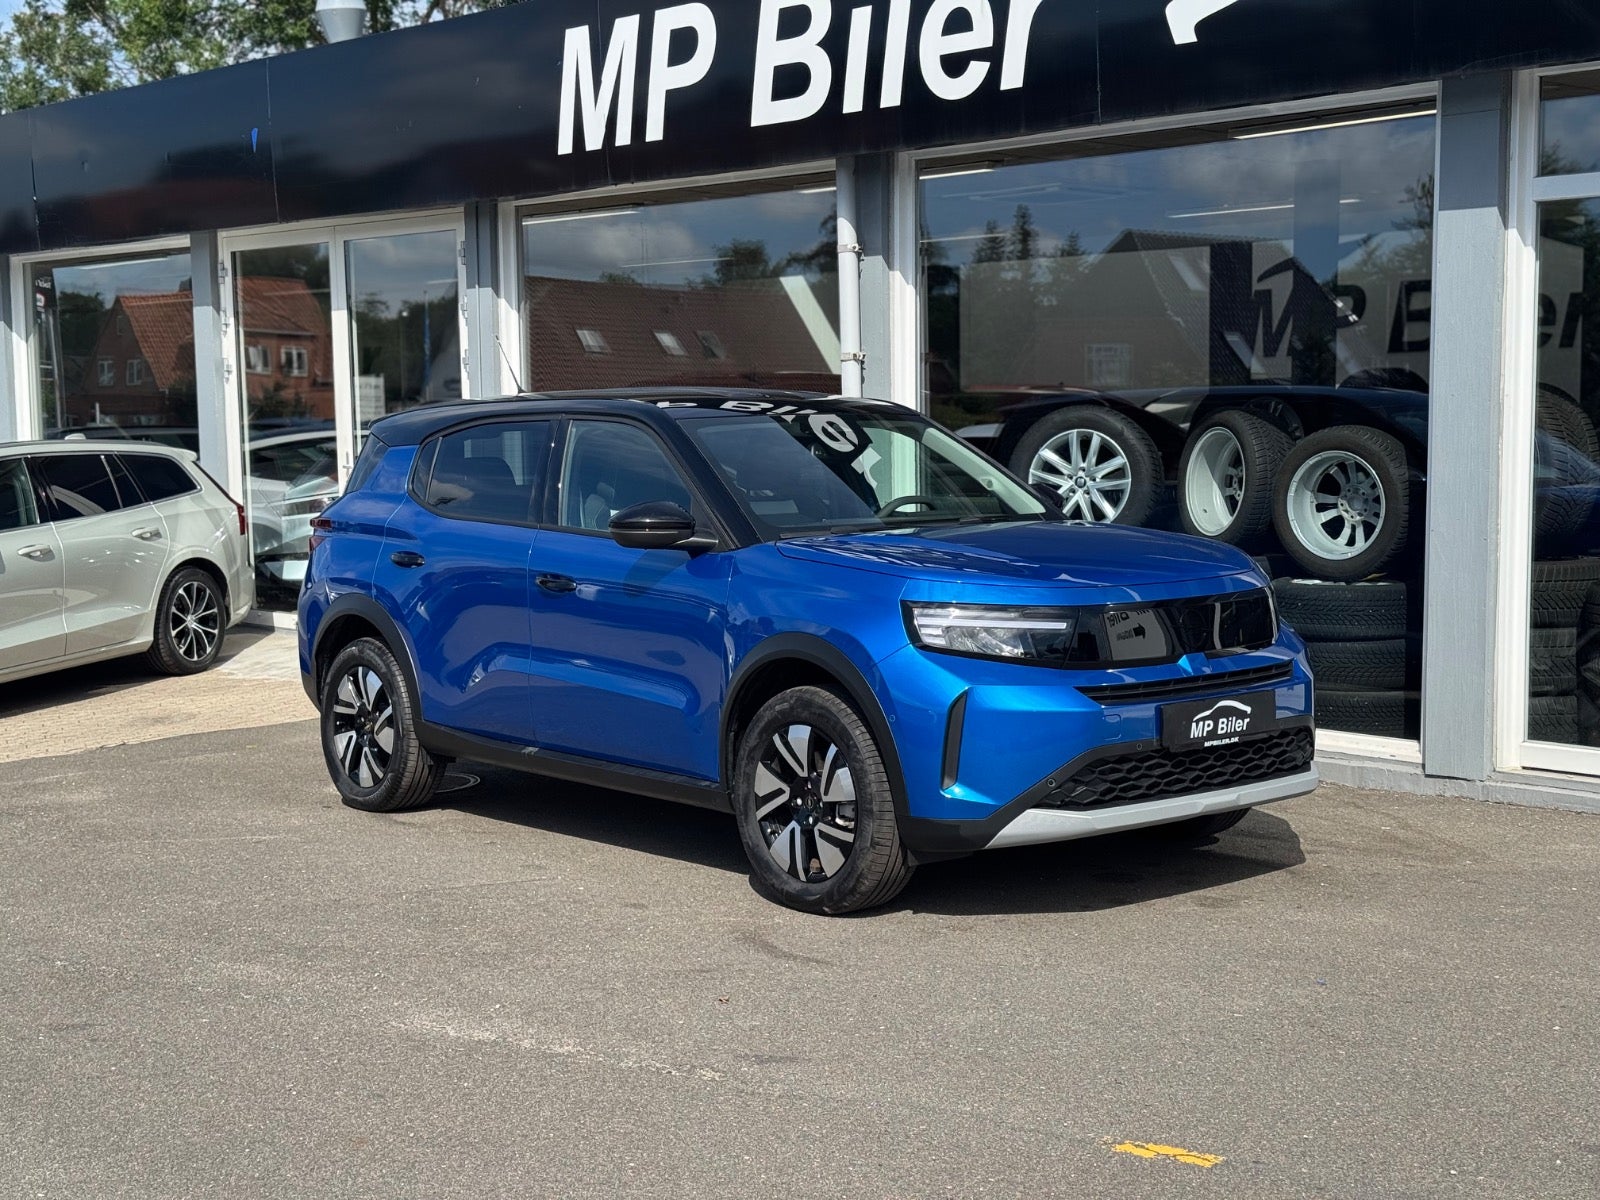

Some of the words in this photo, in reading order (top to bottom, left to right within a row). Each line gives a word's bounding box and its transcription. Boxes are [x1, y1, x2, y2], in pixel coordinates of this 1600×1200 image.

[557, 2, 718, 156] MP
[750, 0, 1045, 127] Biler
[1190, 721, 1213, 738] MP
[1217, 716, 1250, 734] Biler
